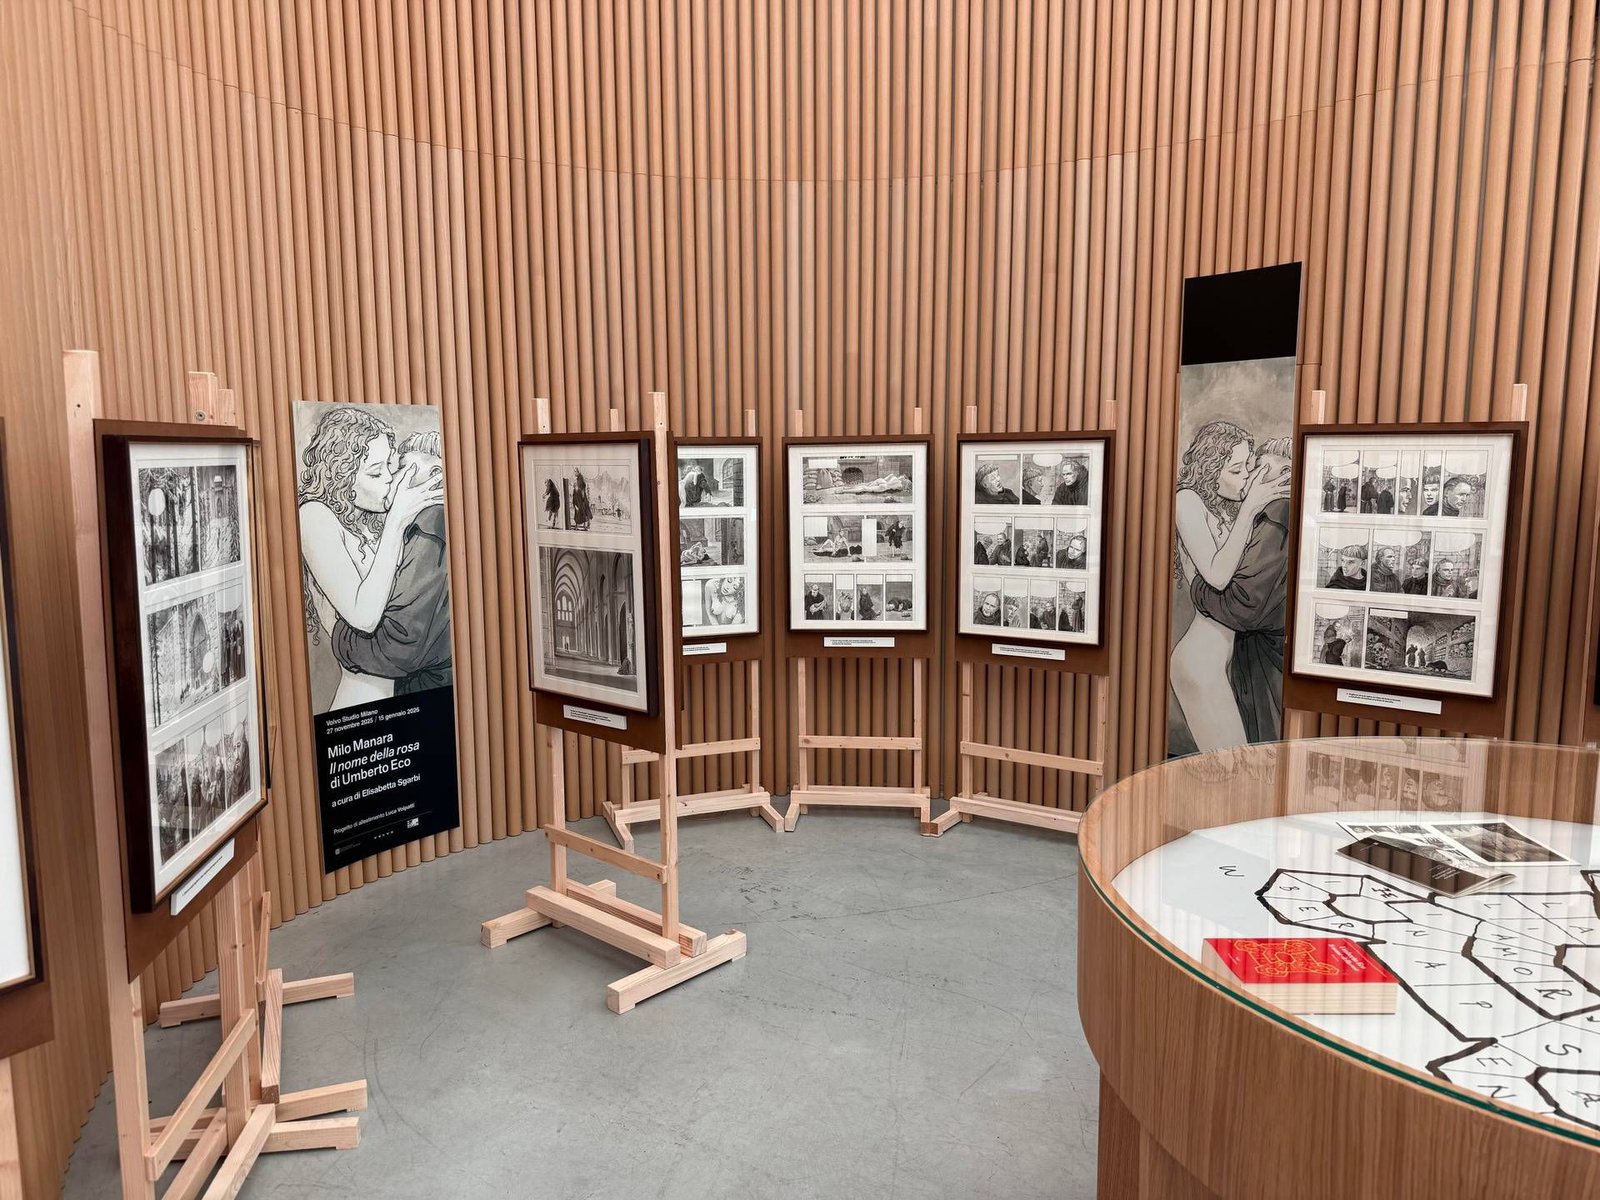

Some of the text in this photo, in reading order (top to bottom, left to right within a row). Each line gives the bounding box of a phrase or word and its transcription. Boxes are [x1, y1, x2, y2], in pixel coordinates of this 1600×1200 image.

[326, 710, 378, 726] Volvo Studio Milano
[334, 722, 360, 732] novembre
[360, 718, 374, 726] 2025
[384, 710, 406, 721] gennaio
[328, 734, 394, 758] Milo Manara
[330, 742, 420, 774] Il nome della rosa
[330, 758, 411, 788] di Umberto Eco
[337, 795, 353, 806] cura
[354, 790, 361, 800] di
[362, 780, 396, 798] Elisabetta
[397, 773, 421, 786] Sgarbi
[1513, 966, 1534, 976] O
[1534, 988, 1573, 1000] R
[1544, 1043, 1582, 1056] S
[1475, 1057, 1512, 1067] E
